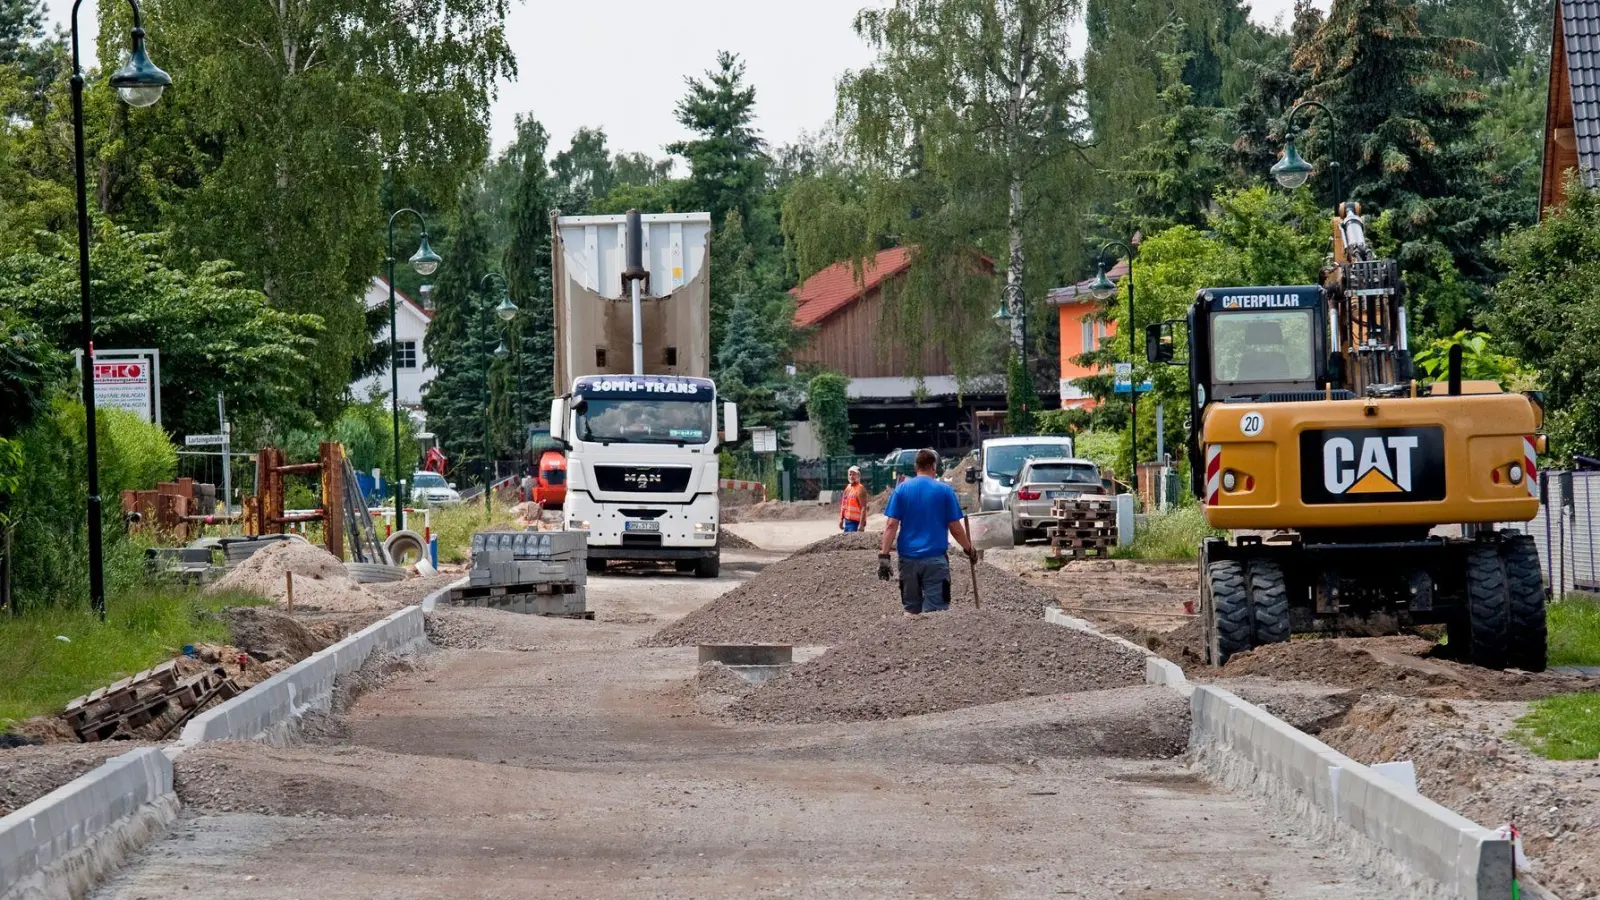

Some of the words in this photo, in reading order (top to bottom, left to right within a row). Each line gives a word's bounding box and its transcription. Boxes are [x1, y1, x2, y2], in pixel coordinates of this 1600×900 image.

[1222, 293, 1300, 308] CATERPILLAR
[592, 381, 697, 394] SOMM-TRANS
[1244, 416, 1260, 432] 20
[1323, 436, 1418, 495] CAT
[624, 474, 662, 482] MAN
